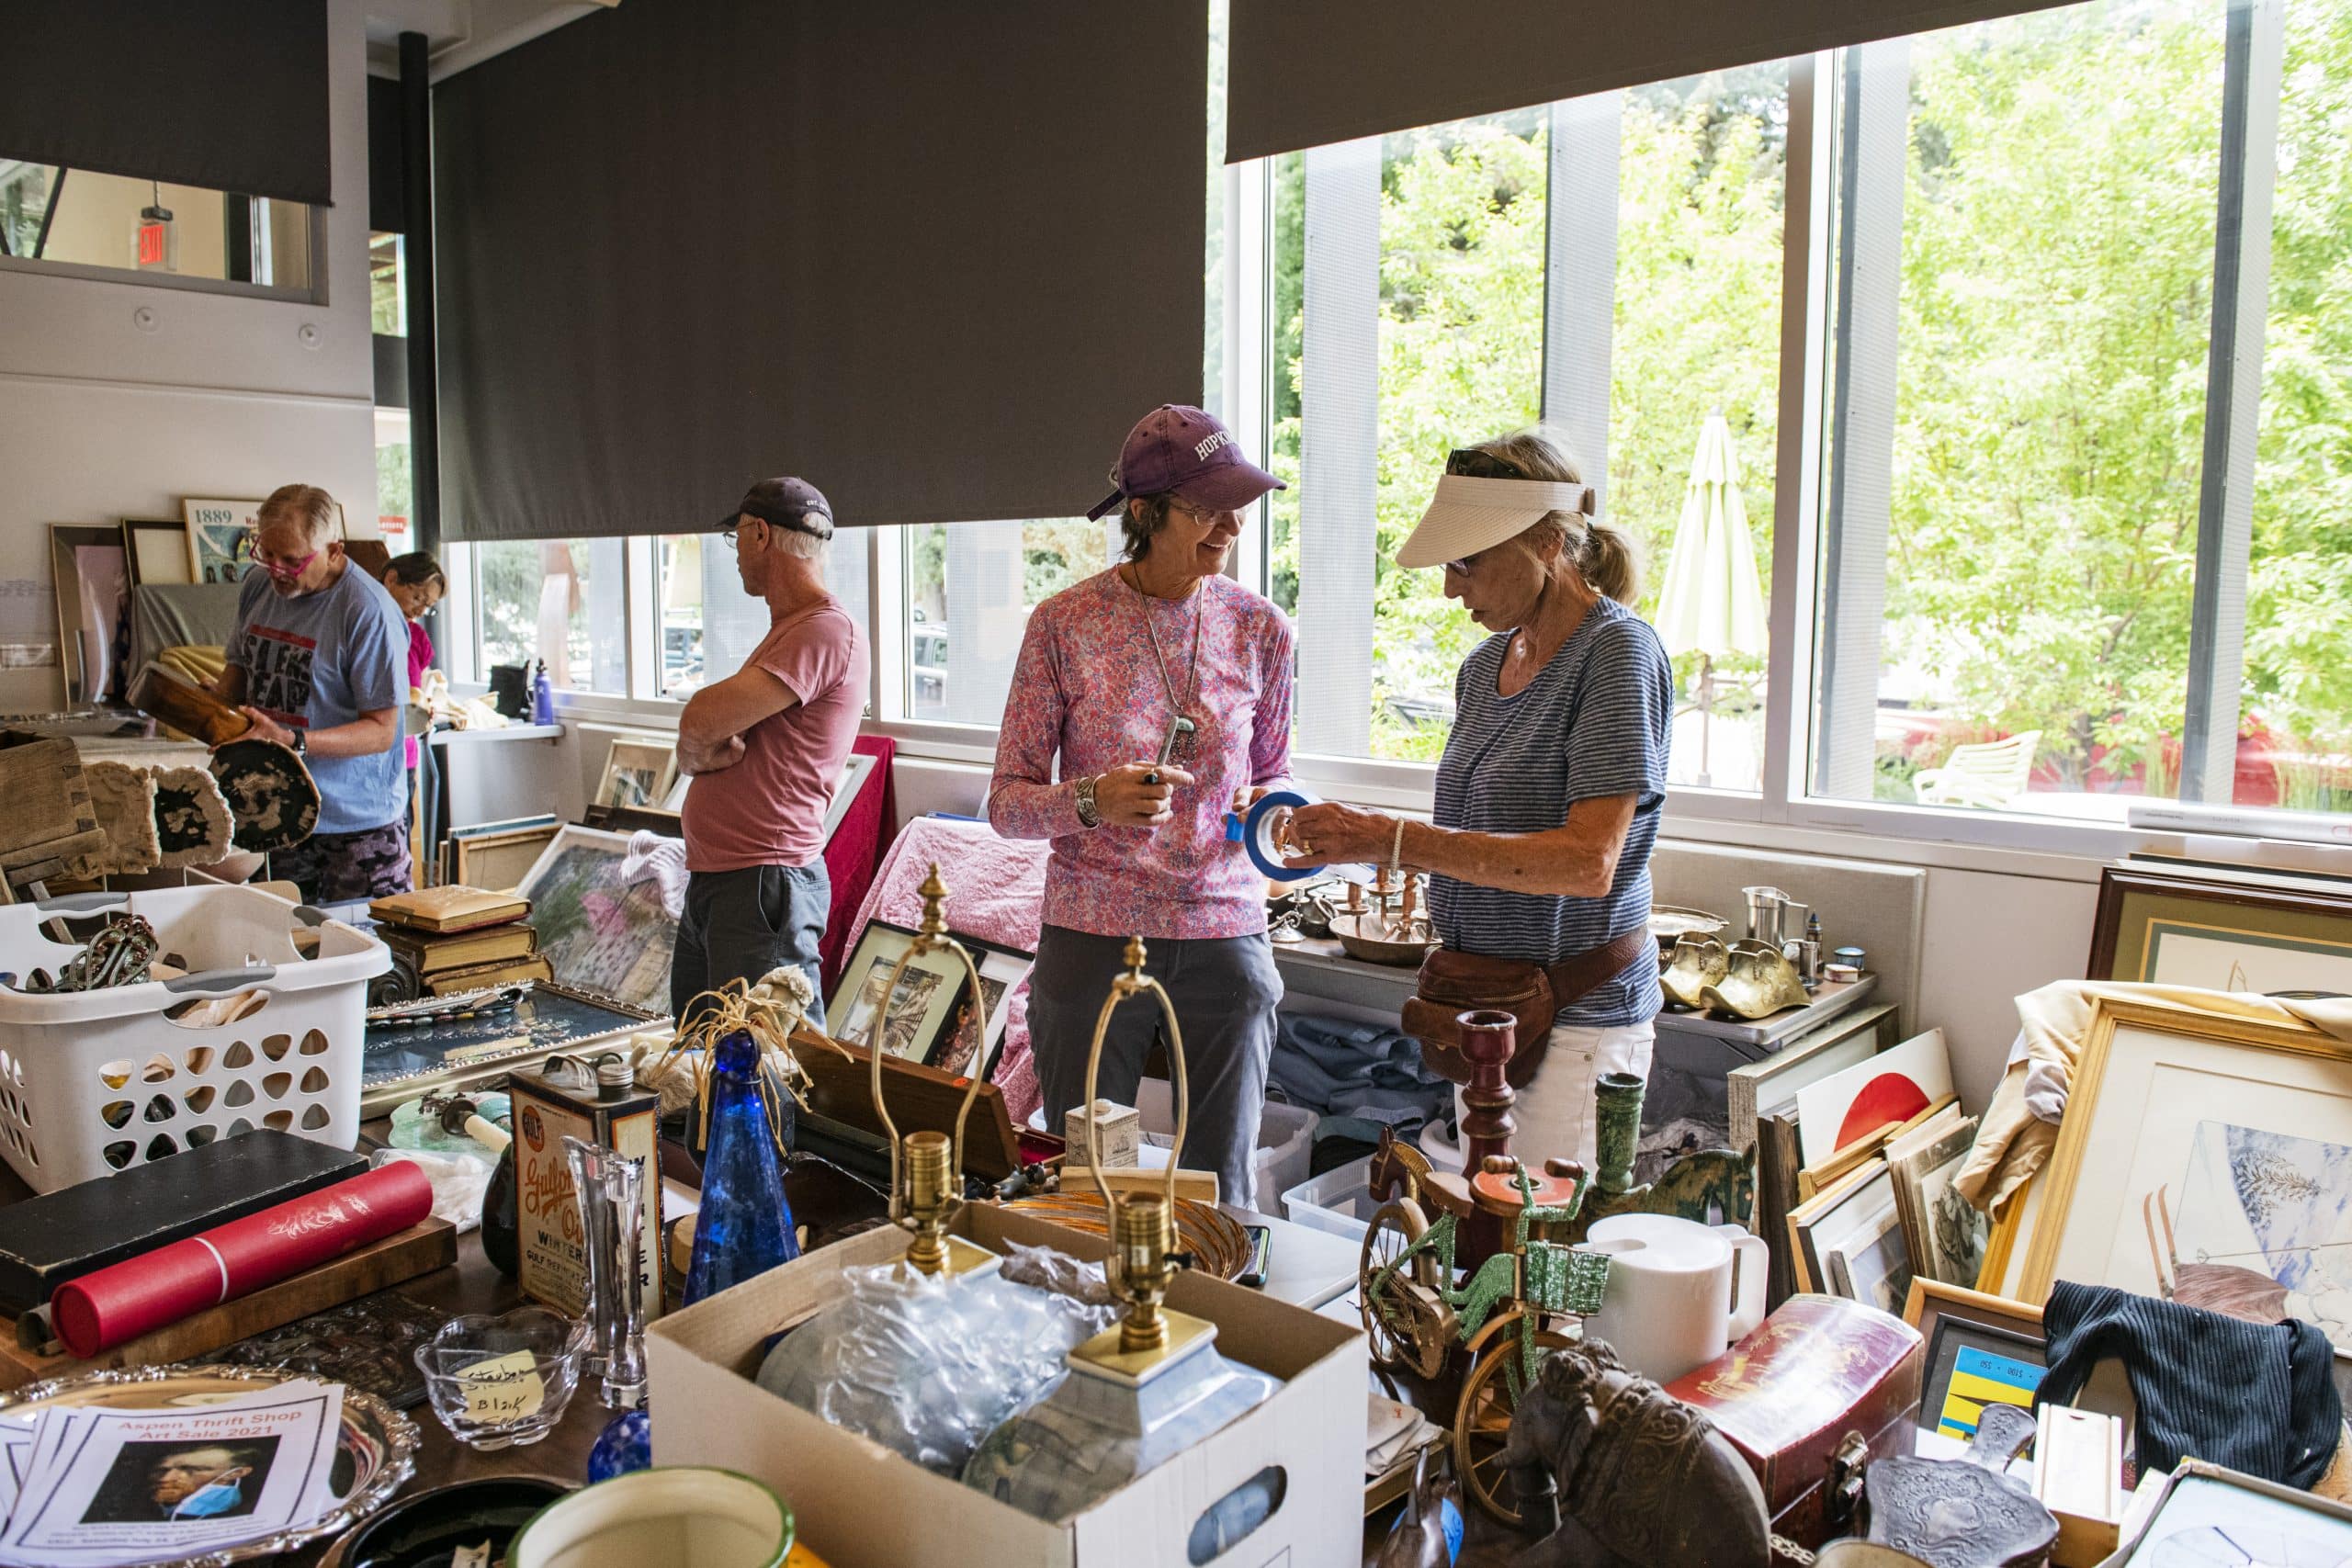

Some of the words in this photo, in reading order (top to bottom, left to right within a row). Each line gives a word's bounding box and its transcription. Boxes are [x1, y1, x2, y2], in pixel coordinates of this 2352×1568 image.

[140, 223, 164, 265] EXIT
[196, 508, 232, 524] 1889
[118, 1422, 184, 1431] Aspen
[191, 1416, 243, 1428] Thrift
[250, 1411, 302, 1424] Shop
[176, 1430, 220, 1439] Sale
[227, 1426, 273, 1438] 2021
